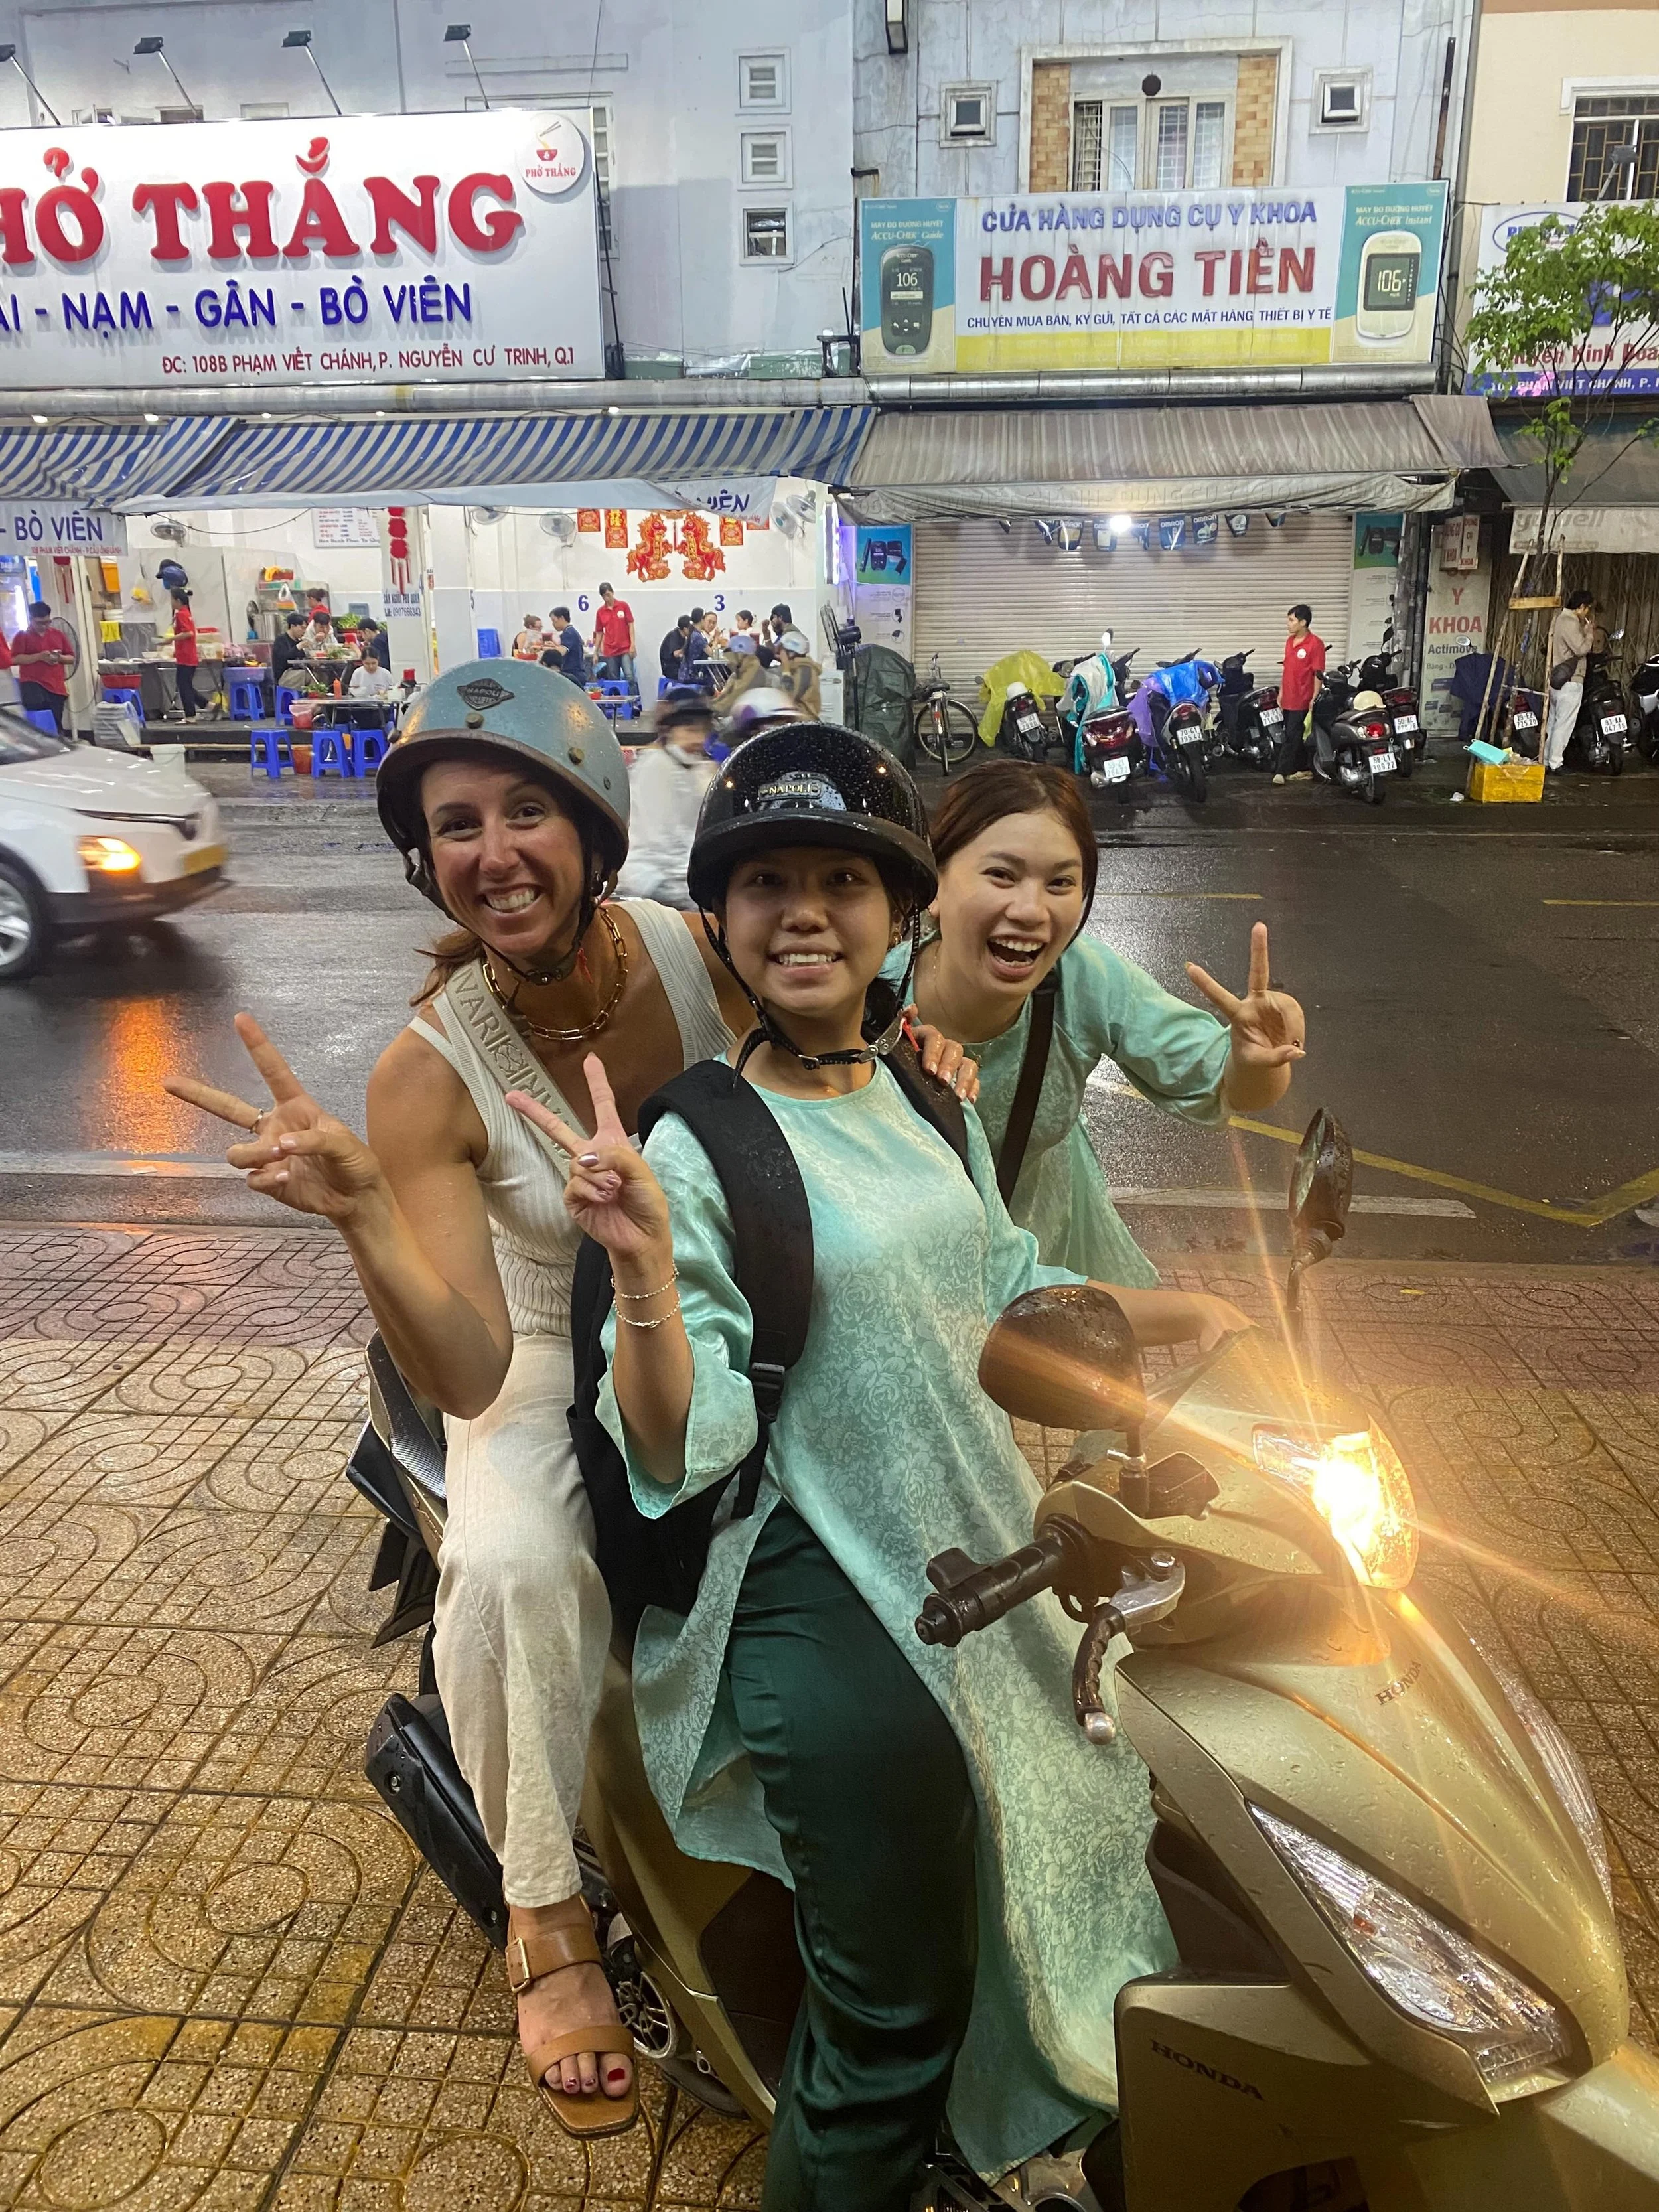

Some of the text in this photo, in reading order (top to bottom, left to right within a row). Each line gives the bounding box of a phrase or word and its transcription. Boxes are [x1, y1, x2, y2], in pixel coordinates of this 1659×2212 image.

[526, 163, 576, 177] PHỞ THẮNG
[133, 137, 522, 260] THẮNG
[982, 202, 1317, 234] CỬA HÀNG DỤNG CỤ Y KHOA
[897, 272, 918, 287] 106
[980, 243, 1175, 302] HOÀNG
[1377, 269, 1402, 292] 106
[62, 291, 153, 338] NẠM
[320, 275, 368, 325] BÒ
[383, 275, 471, 323] VIÊN
[968, 315, 1013, 328] CHUYÊN
[1016, 315, 1043, 327] MUA
[1046, 313, 1072, 327] BÁN,
[1076, 312, 1091, 325] KÝ
[1163, 310, 1187, 323] CÁC
[1220, 308, 1253, 322] HÀNG
[1307, 309, 1315, 320] Y
[161, 355, 187, 374] ĐC:
[192, 354, 228, 373] 108B
[233, 353, 277, 376] PHẠM
[282, 346, 313, 372] VIẾT
[399, 342, 463, 368] NGUYỄN
[473, 344, 496, 366] CƯ
[504, 347, 551, 368] TRINH,
[555, 346, 574, 365] Q.1
[15, 509, 42, 541] BÒ
[51, 510, 103, 541] VIÊN
[1194, 514, 1218, 524] OMRON
[577, 594, 590, 612] 6
[714, 594, 726, 611] 3
[1452, 588, 1464, 605] Y
[1429, 615, 1482, 633] KHOA
[768, 784, 810, 794] NAPOLI
[1375, 1659, 1421, 1705] HONDA
[1150, 2039, 1265, 2102] HONDA
